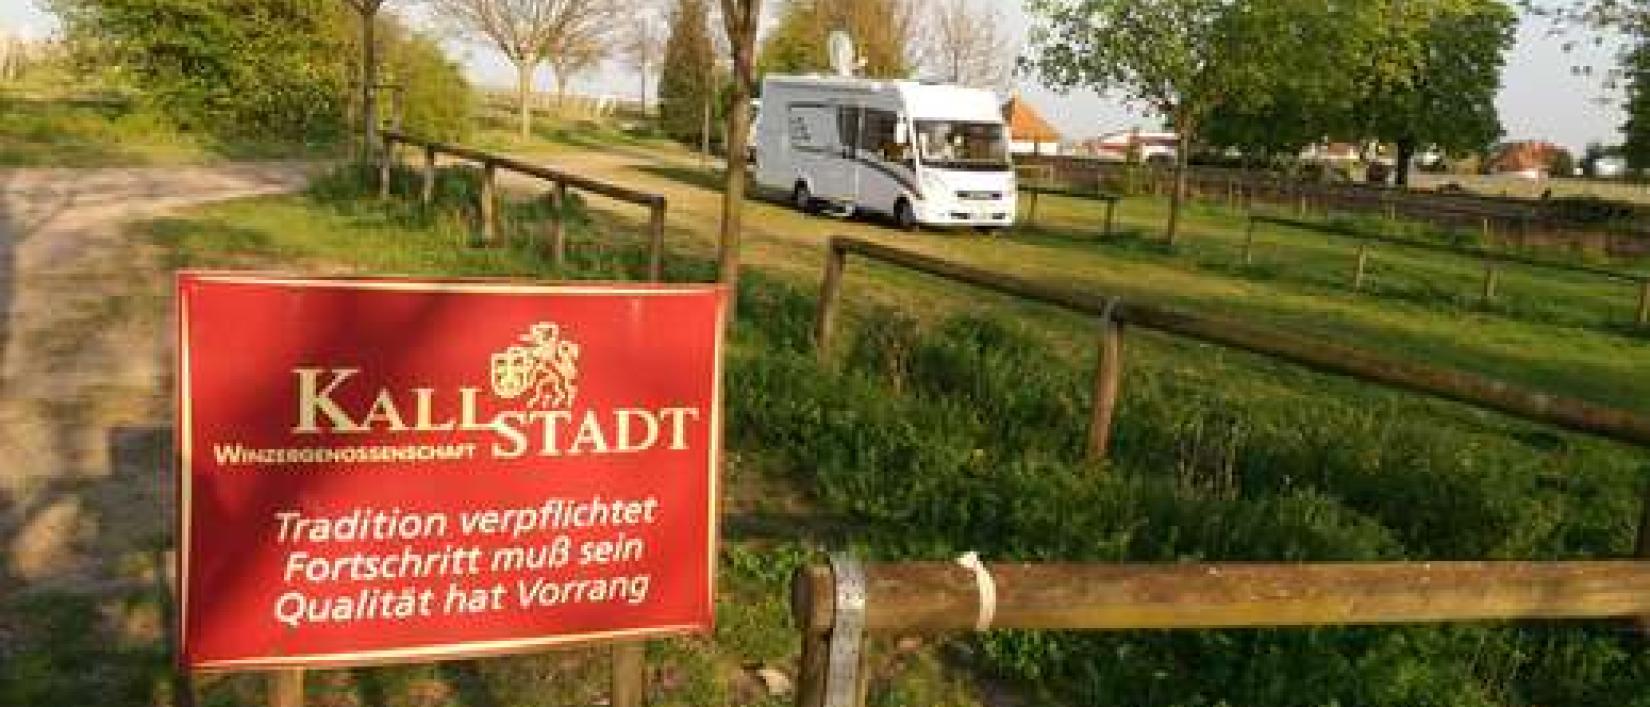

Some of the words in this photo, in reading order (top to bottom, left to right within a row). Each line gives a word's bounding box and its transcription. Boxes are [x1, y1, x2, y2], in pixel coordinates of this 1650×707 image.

[491, 408, 700, 458] STADT
[274, 510, 447, 543] Tradition
[459, 498, 659, 535] verpflichtet
[283, 545, 480, 582] Fortschritt
[490, 537, 569, 572] muß
[579, 531, 643, 566] sein
[273, 590, 432, 627] Qualität
[442, 583, 505, 614] hat
[516, 573, 651, 608] Vorrang
